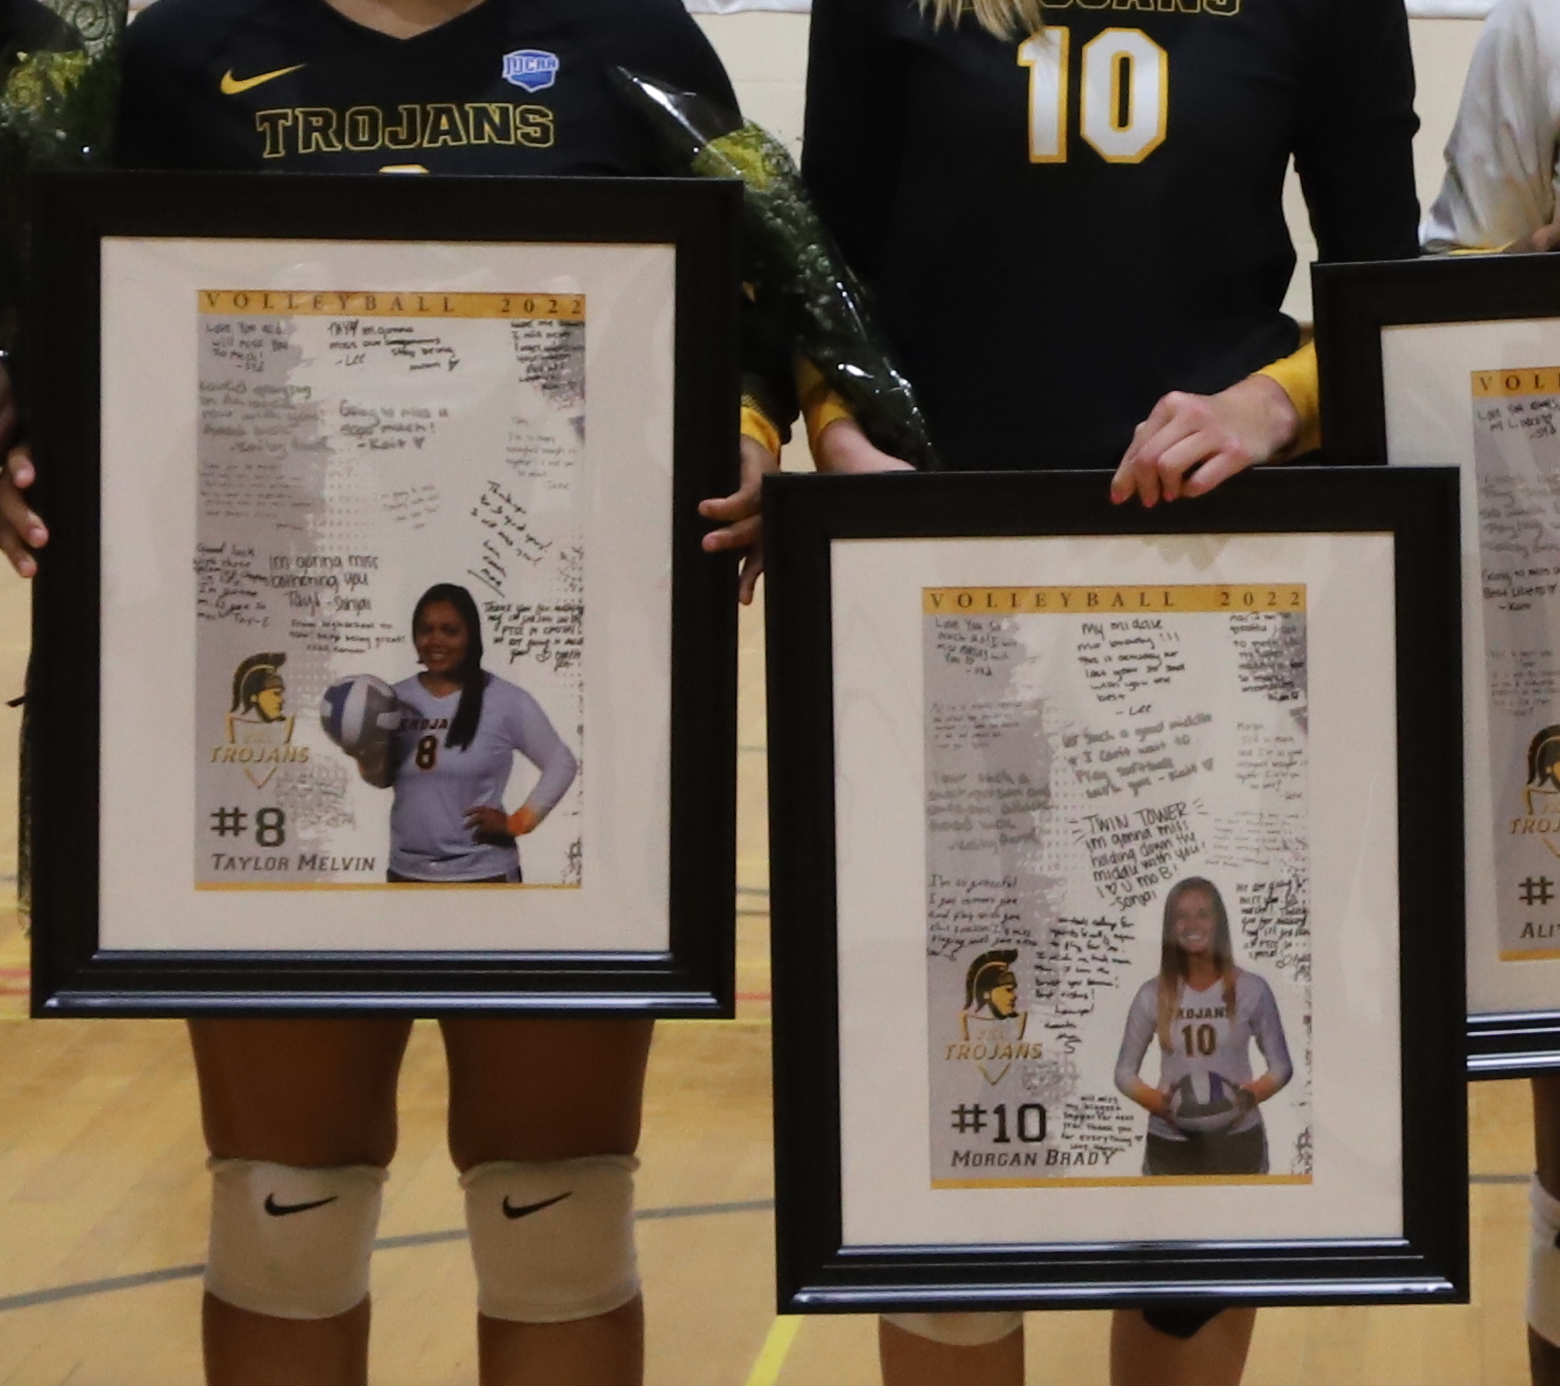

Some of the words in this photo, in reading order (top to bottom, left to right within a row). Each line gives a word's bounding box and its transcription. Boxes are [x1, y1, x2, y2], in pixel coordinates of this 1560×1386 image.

[1016, 24, 1169, 164] 10
[255, 102, 555, 159] TROJANS
[206, 293, 456, 312] VOLLEYBALL
[501, 298, 581, 314] 2022
[930, 591, 1174, 609] VOLLEYBALL
[1220, 590, 1301, 608] 2022
[210, 746, 311, 764] TROJANS
[415, 734, 440, 771] 8
[210, 807, 287, 847] #8
[944, 1042, 1043, 1061] TROJANS
[1180, 1023, 1217, 1057] 10
[951, 1103, 1048, 1144] #10
